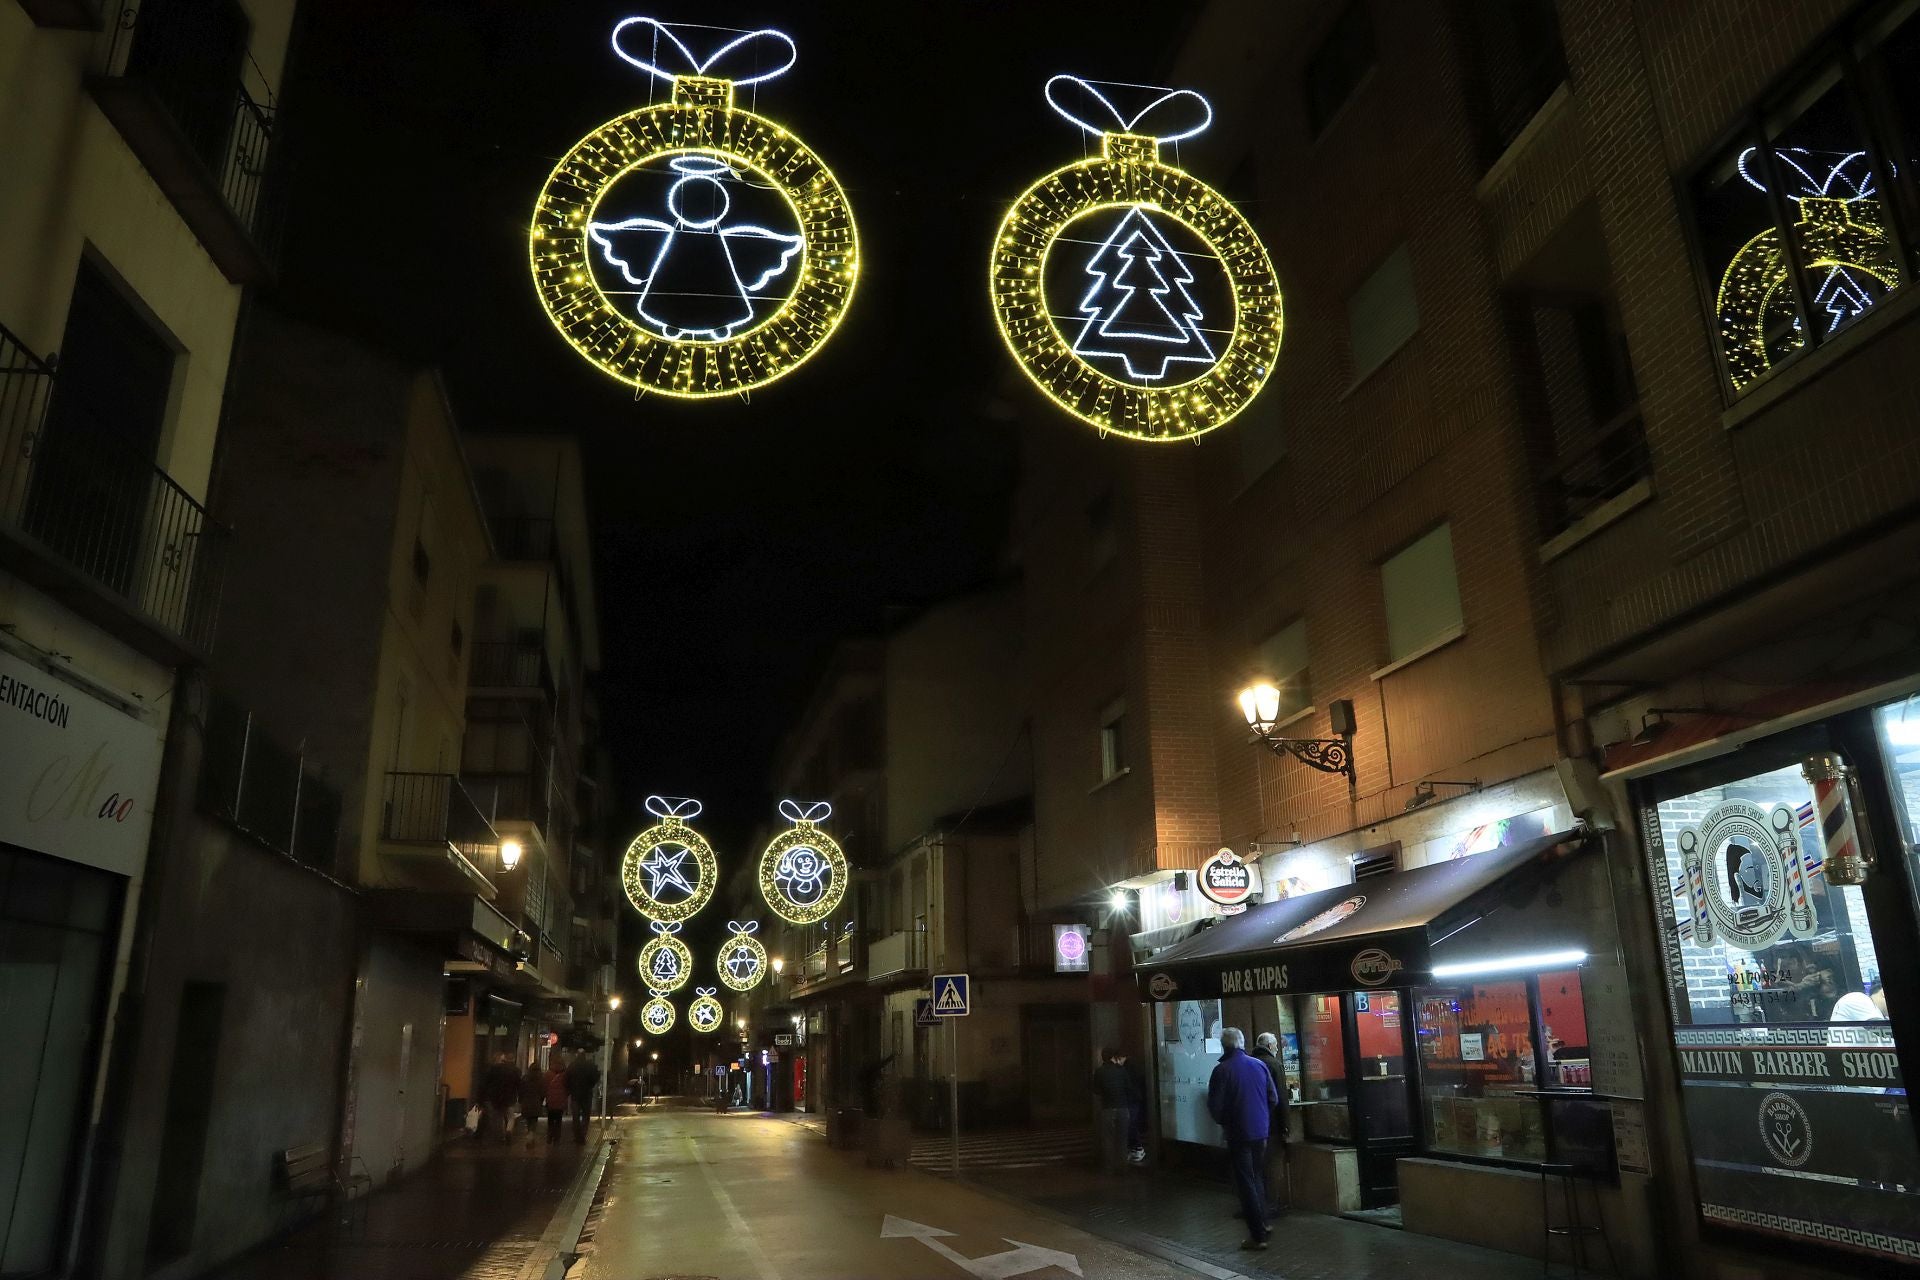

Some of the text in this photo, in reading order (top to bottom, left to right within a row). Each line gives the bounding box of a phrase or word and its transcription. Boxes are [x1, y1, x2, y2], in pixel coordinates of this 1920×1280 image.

[1721, 805, 1747, 817] BARBER
[1748, 807, 1765, 820] SHOP
[1647, 808, 1662, 848] SHOP
[1210, 866, 1246, 877] Estrella
[1212, 876, 1245, 887] Galicia
[1655, 856, 1674, 918] BARBER
[1221, 964, 1288, 992] BAR & TAPAS
[1727, 972, 1744, 985] 921
[1779, 969, 1792, 982] 24
[1357, 995, 1368, 1011] B
[1731, 992, 1750, 1004] 643
[1681, 1051, 1899, 1080] MALVIN BARBER SHOP
[1767, 1102, 1796, 1119] BARBER
[1774, 1113, 1790, 1121] SHOP
